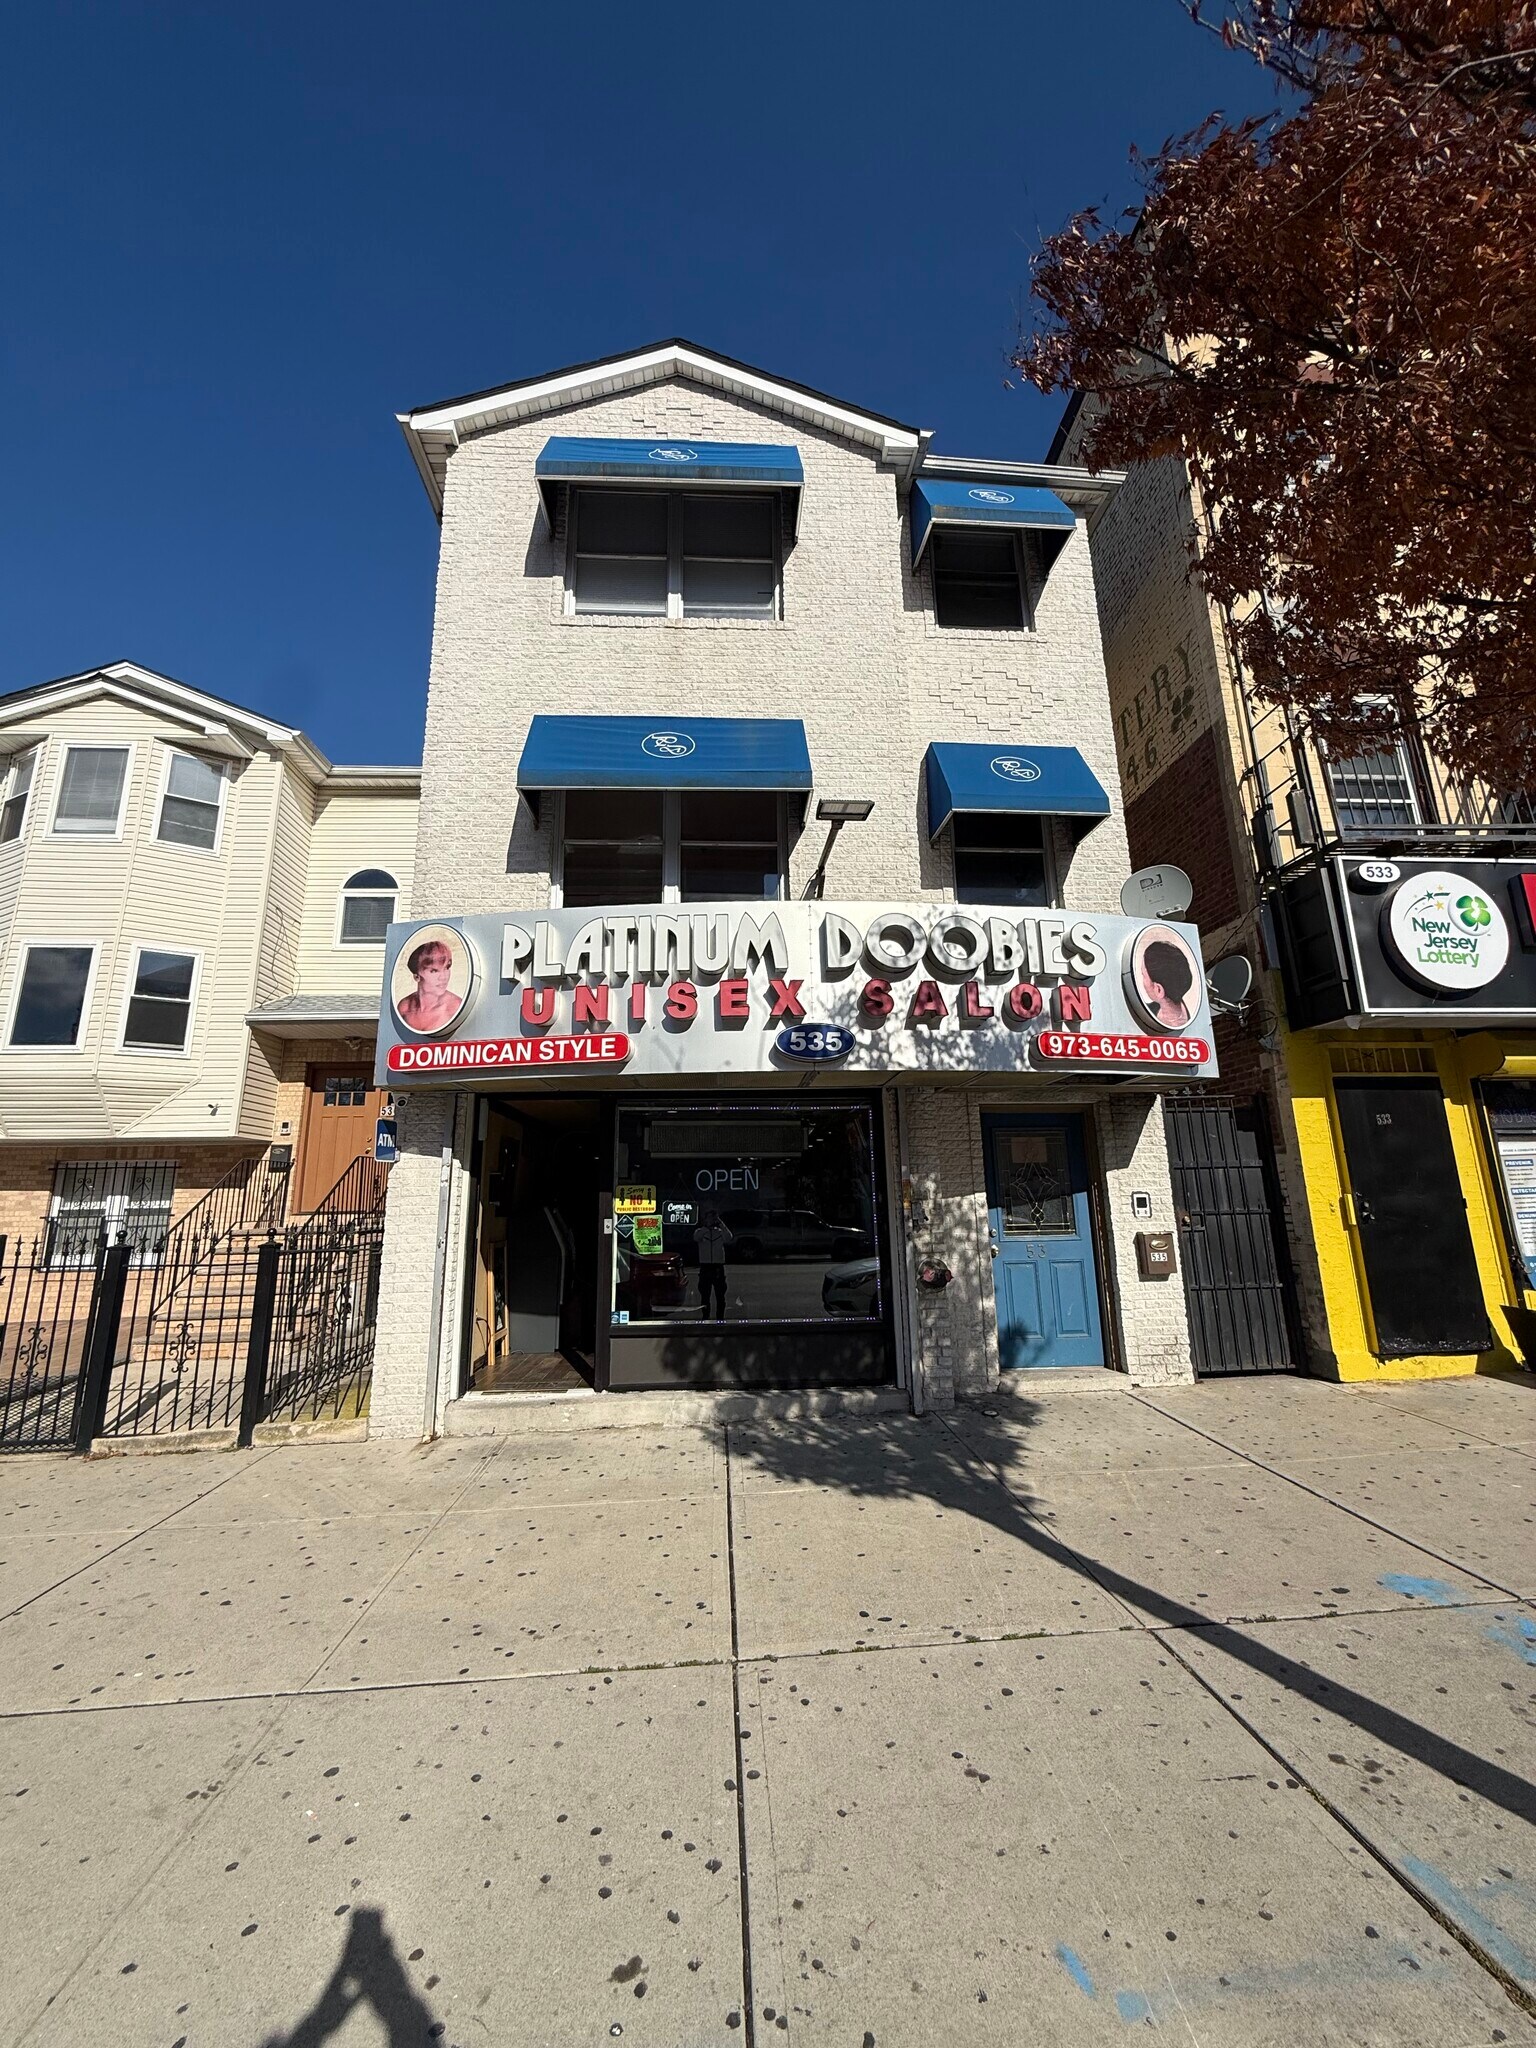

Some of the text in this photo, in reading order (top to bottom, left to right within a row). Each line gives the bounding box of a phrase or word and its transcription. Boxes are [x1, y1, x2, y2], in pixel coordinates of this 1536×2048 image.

[1365, 866, 1394, 879] 533
[1412, 917, 1450, 934] New
[502, 911, 1107, 984] PLATINUM DOOBIES
[1424, 933, 1478, 953] Jersey
[1416, 947, 1480, 968] Lottery
[521, 977, 1093, 1026] UNISEX SALON
[789, 1031, 843, 1052] 535
[1048, 1035, 1201, 1061] 973-645-0065
[399, 1037, 617, 1067] DOMINICAN STYLE
[1376, 1113, 1392, 1125] 533
[377, 1133, 396, 1148] ATM
[695, 1169, 760, 1192] OPEN
[629, 1194, 644, 1206] NO
[667, 1202, 685, 1212] Come
[670, 1213, 690, 1223] OPEN
[1152, 1253, 1167, 1261] 535
